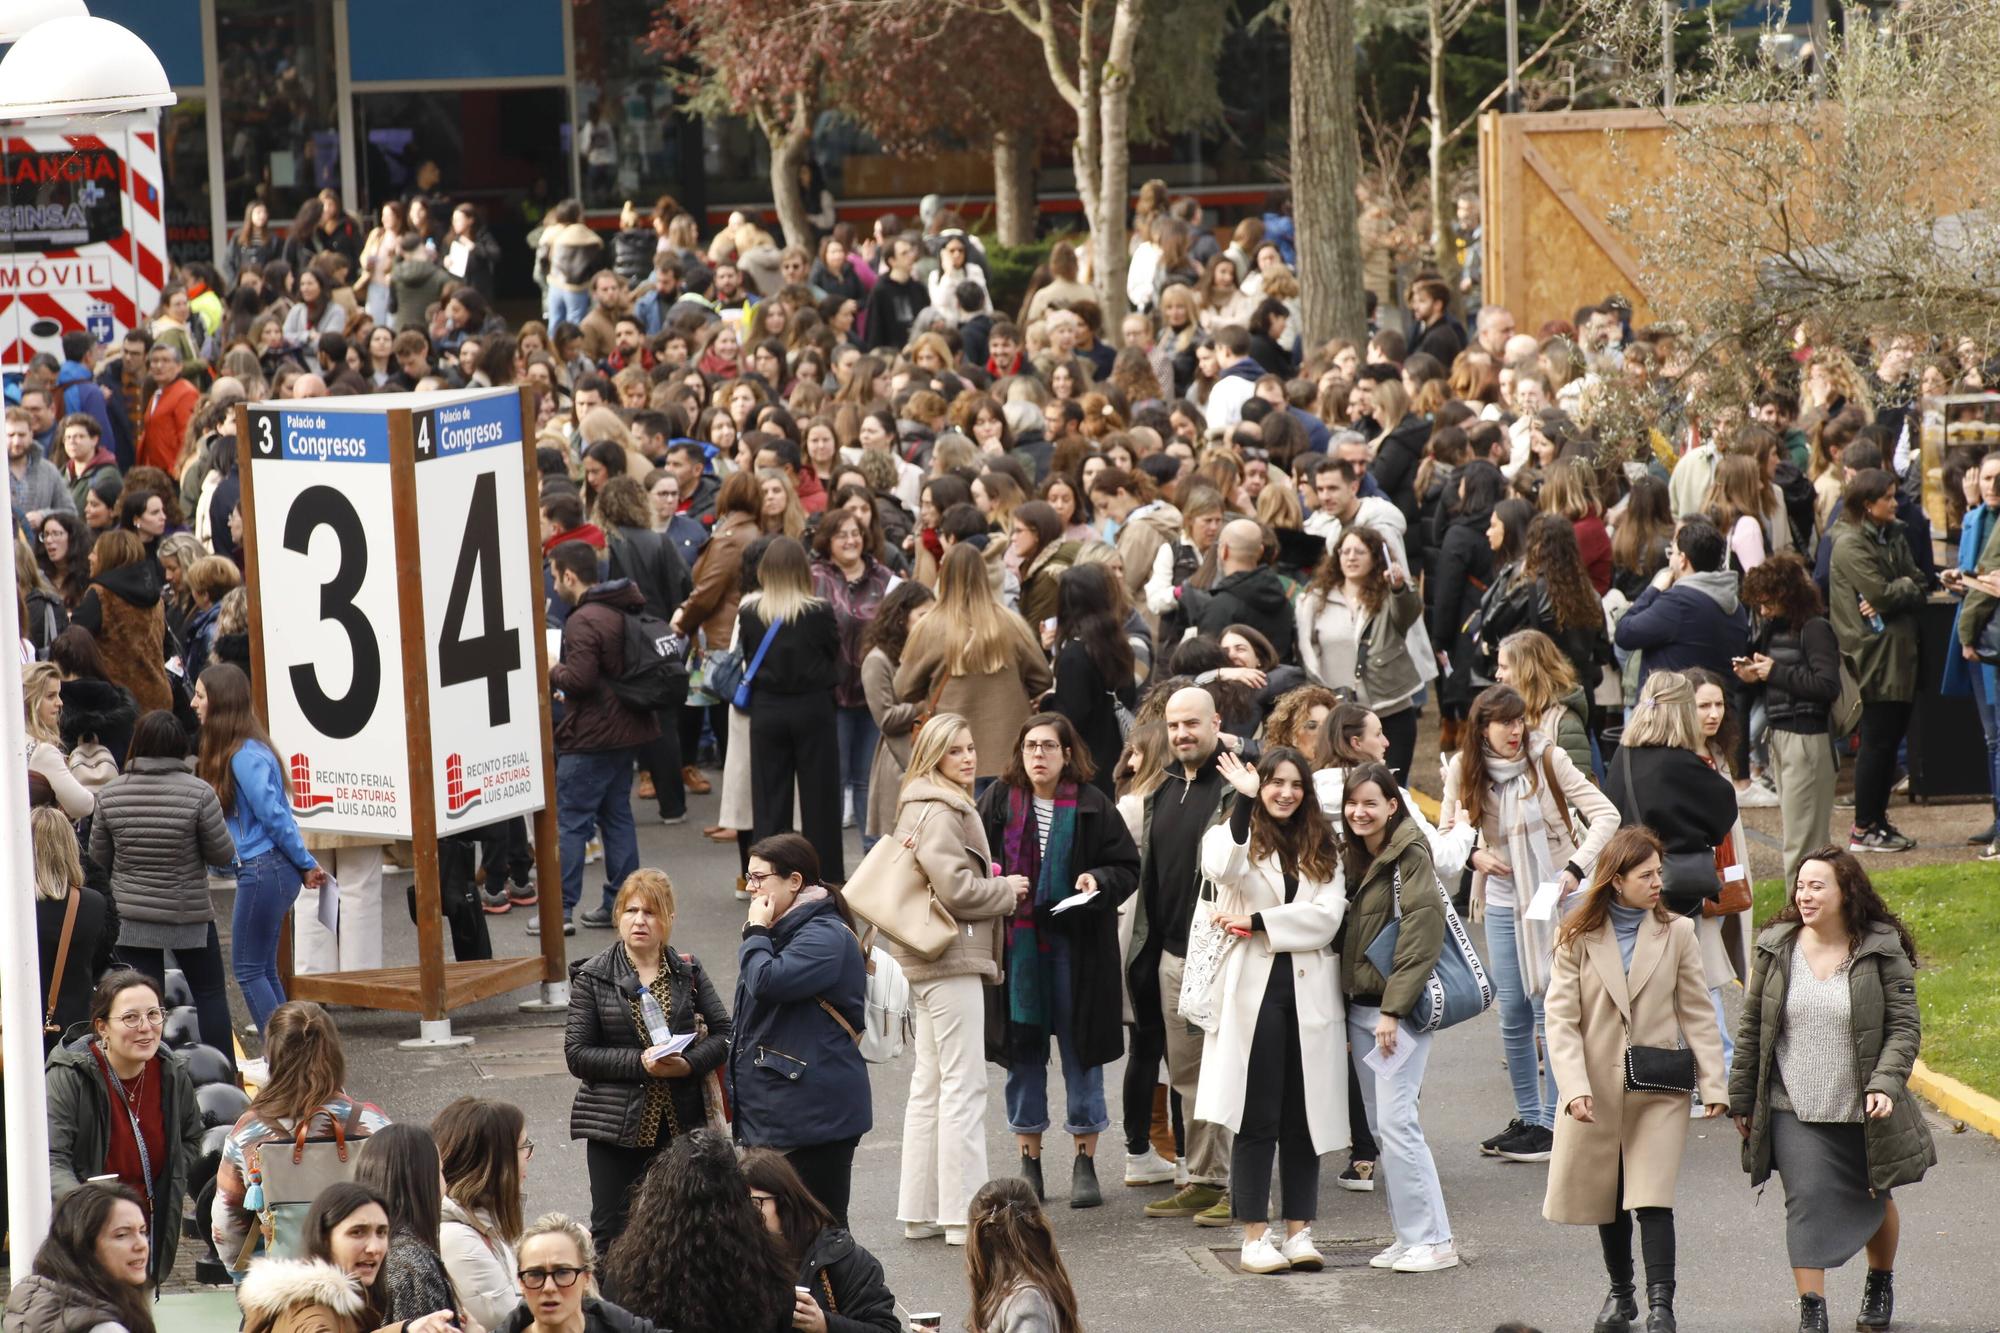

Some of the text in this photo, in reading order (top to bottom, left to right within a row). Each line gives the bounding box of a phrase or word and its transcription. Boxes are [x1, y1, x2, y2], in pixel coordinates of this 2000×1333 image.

[0, 260, 103, 288] MÓVIL
[287, 414, 326, 430] Palacio de
[440, 405, 471, 424] Palacio de
[258, 415, 274, 454] 3
[288, 431, 366, 461] Congresos
[417, 415, 430, 454] 4
[441, 421, 502, 452] Congresos
[283, 485, 381, 739] 3
[438, 471, 521, 728] 4
[316, 770, 395, 788] RECINTO FERIAL
[466, 751, 529, 779] RECINTO FERIAL
[483, 765, 530, 789] DE ASTURIAS
[336, 787, 396, 803] DE ASTURIAS
[484, 780, 532, 804] LUIS ADARO
[337, 802, 397, 818] LUIS ADARO
